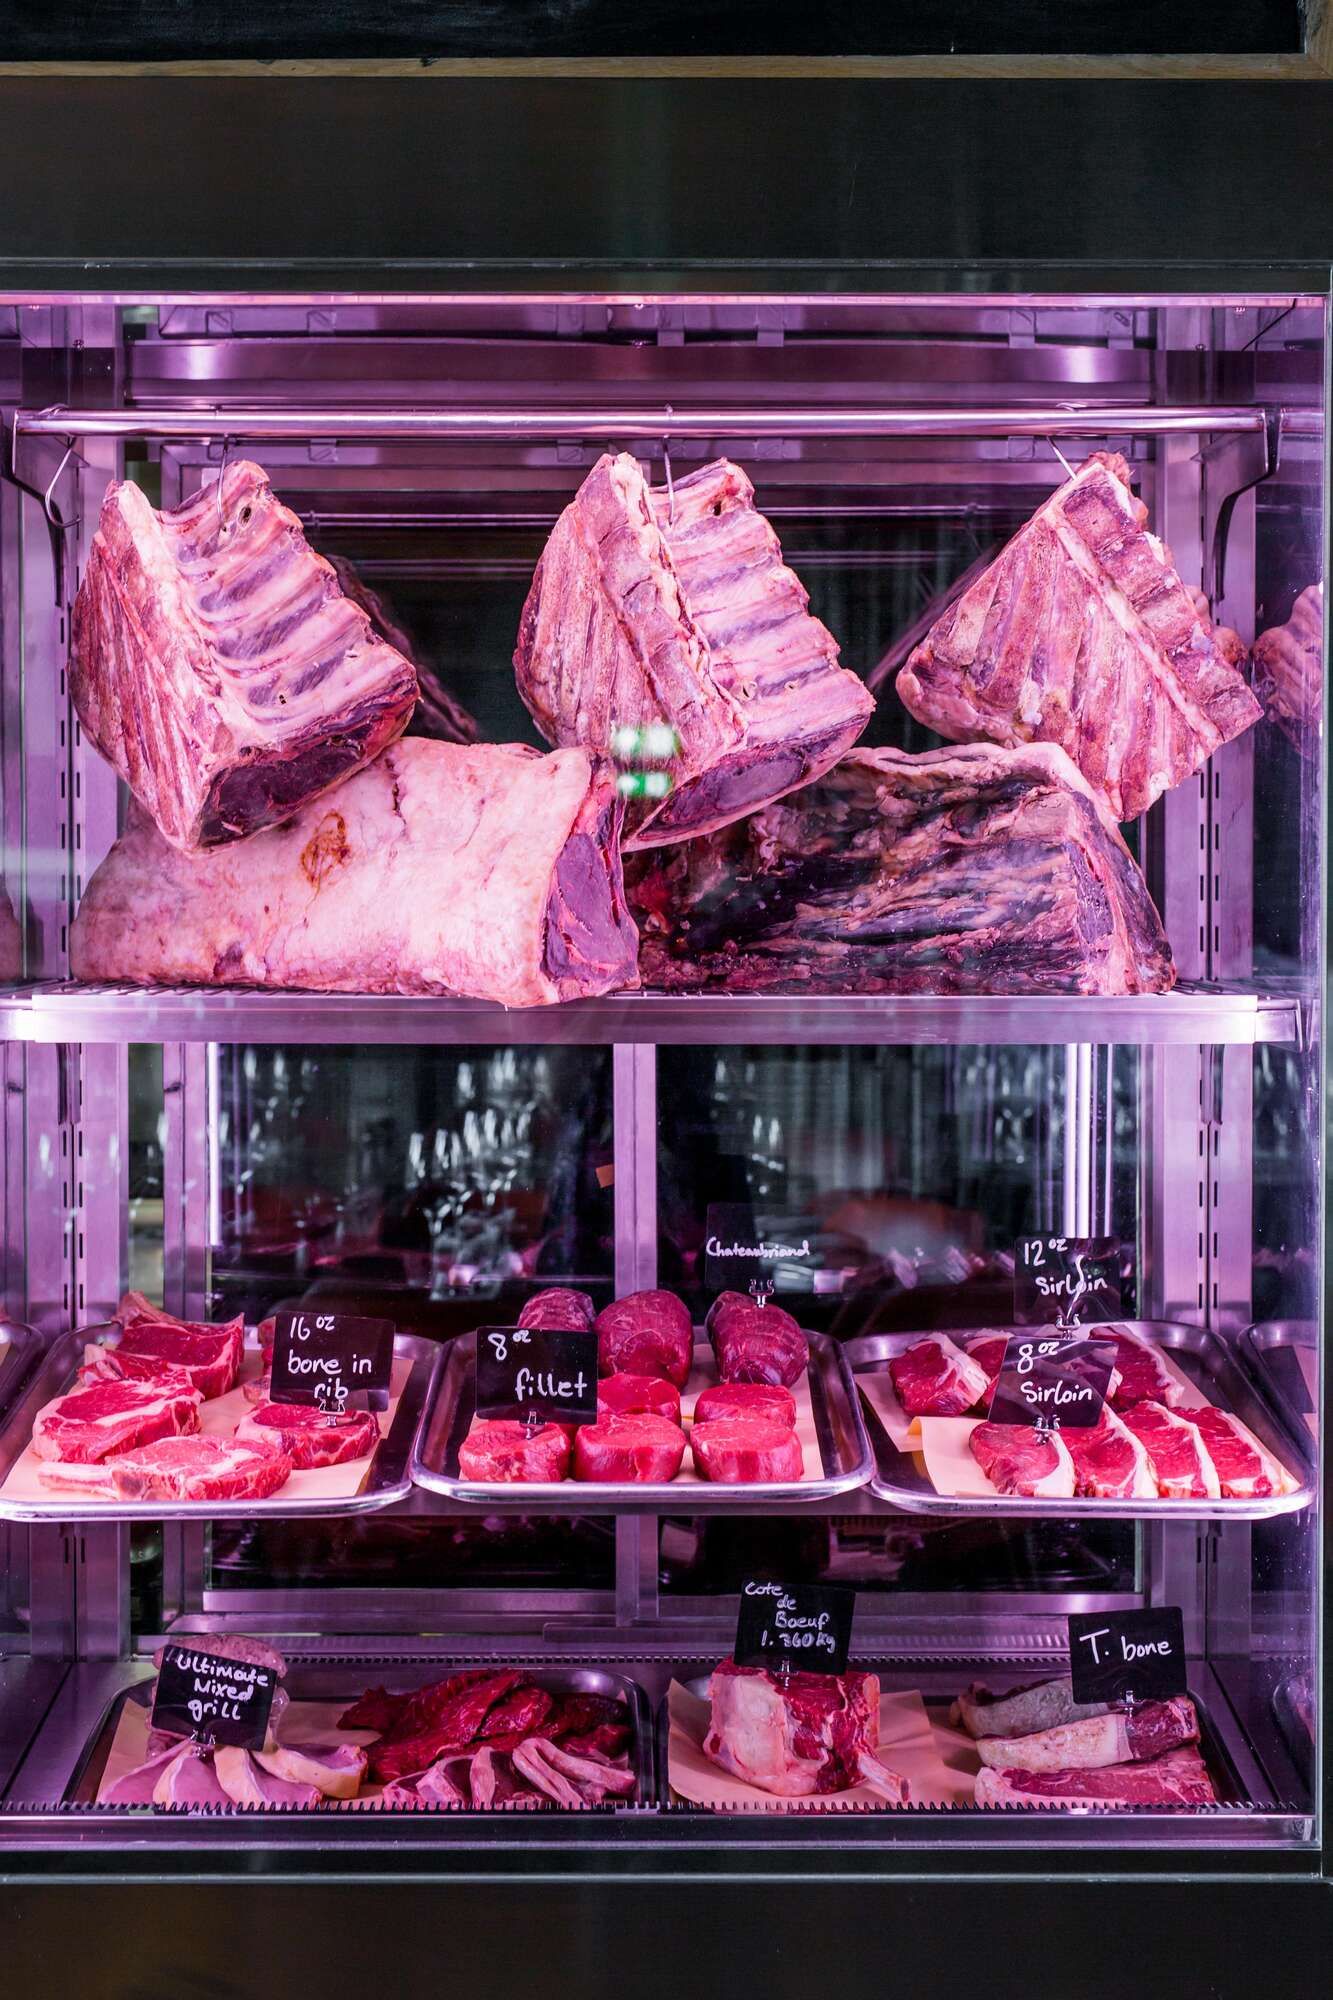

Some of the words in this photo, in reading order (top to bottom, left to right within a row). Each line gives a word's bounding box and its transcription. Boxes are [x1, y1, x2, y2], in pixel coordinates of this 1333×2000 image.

[1024, 1240, 1046, 1266] 12
[290, 1316, 311, 1340] 16
[315, 1315, 335, 1331] oz
[487, 1332, 508, 1360] 8
[1017, 1343, 1034, 1374] 8
[1038, 1341, 1060, 1355] oz
[287, 1349, 342, 1375] bone
[352, 1353, 372, 1374] in
[313, 1377, 349, 1399] rib
[514, 1367, 588, 1401] fillet
[1020, 1380, 1093, 1405] Sirloin
[744, 1581, 784, 1596] Cote
[776, 1593, 797, 1611] de
[774, 1610, 830, 1631] Boeuf
[1120, 1635, 1172, 1661] bone
[193, 1677, 254, 1701] Mixed
[187, 1698, 241, 1722] grill
